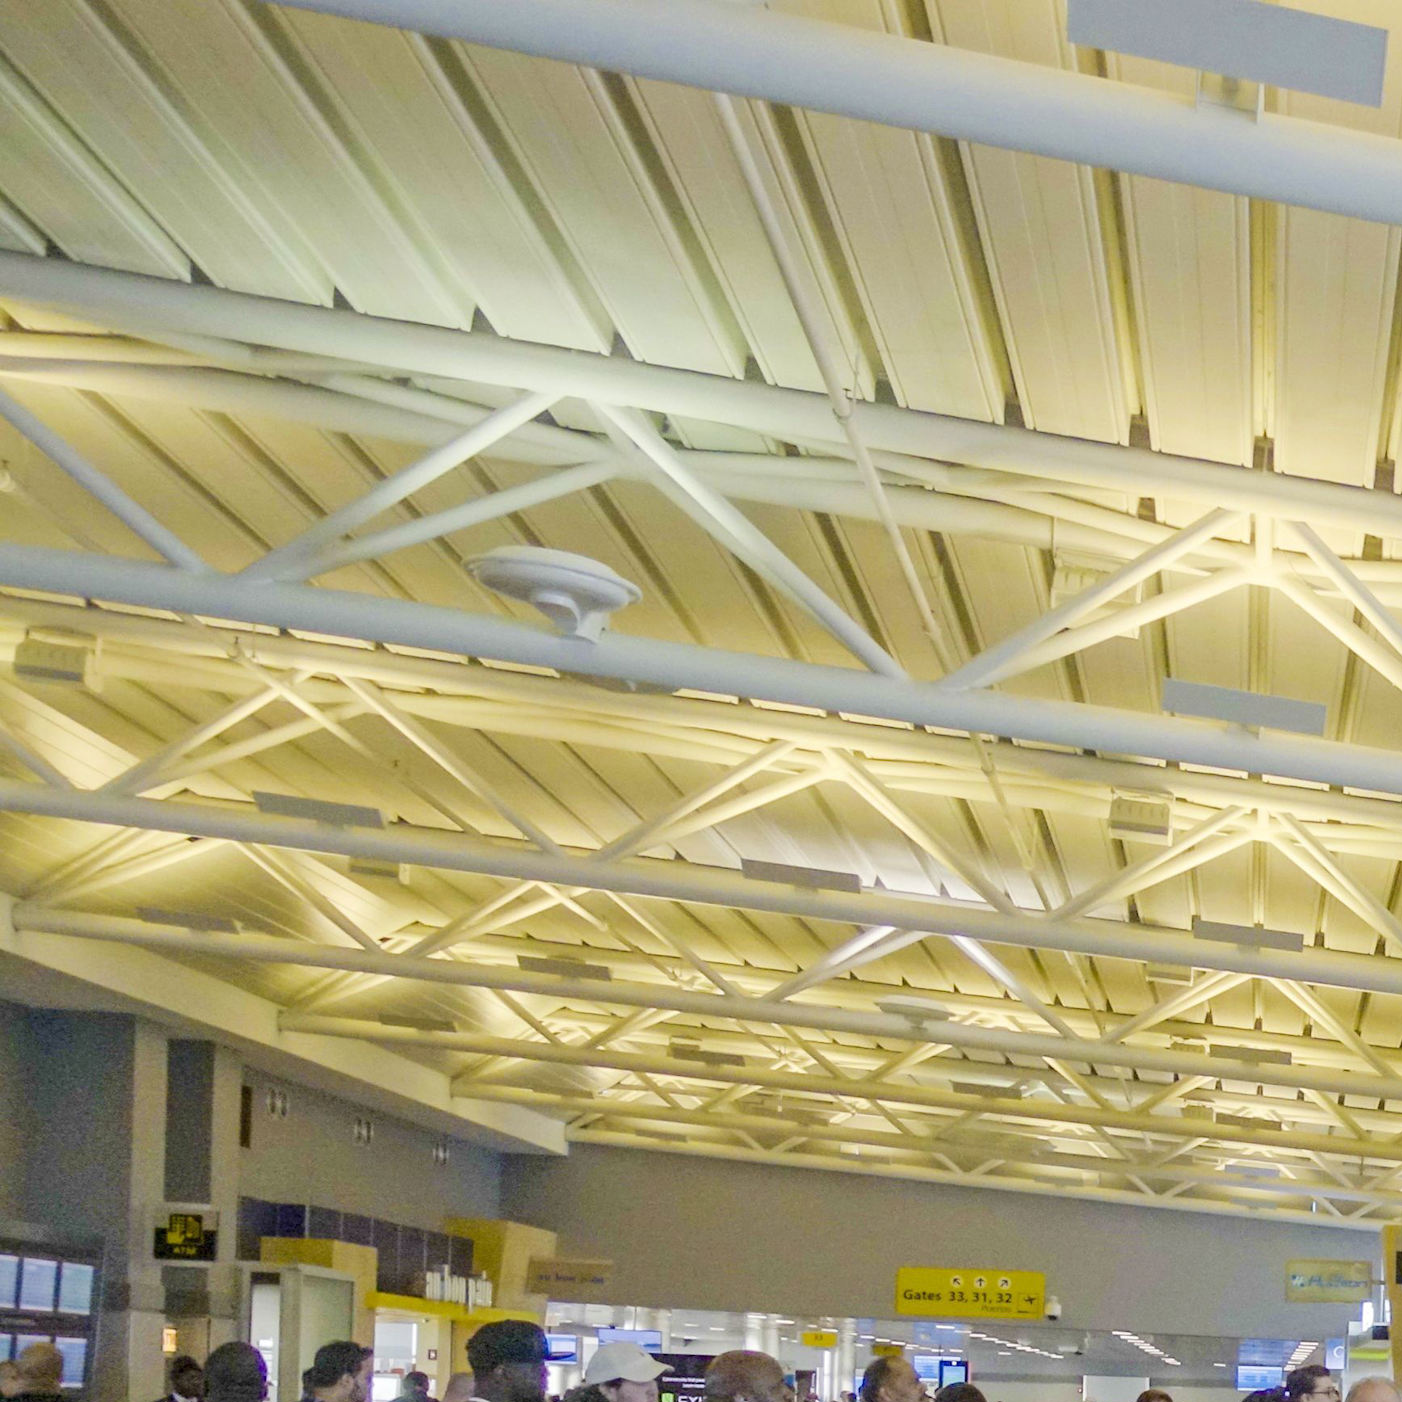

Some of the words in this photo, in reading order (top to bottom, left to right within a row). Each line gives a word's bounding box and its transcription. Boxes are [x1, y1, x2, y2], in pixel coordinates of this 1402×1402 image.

[903, 1289, 942, 1301] Gates
[949, 1291, 968, 1304] 33,
[973, 1292, 992, 1304] 31,
[997, 1292, 1012, 1304] 32
